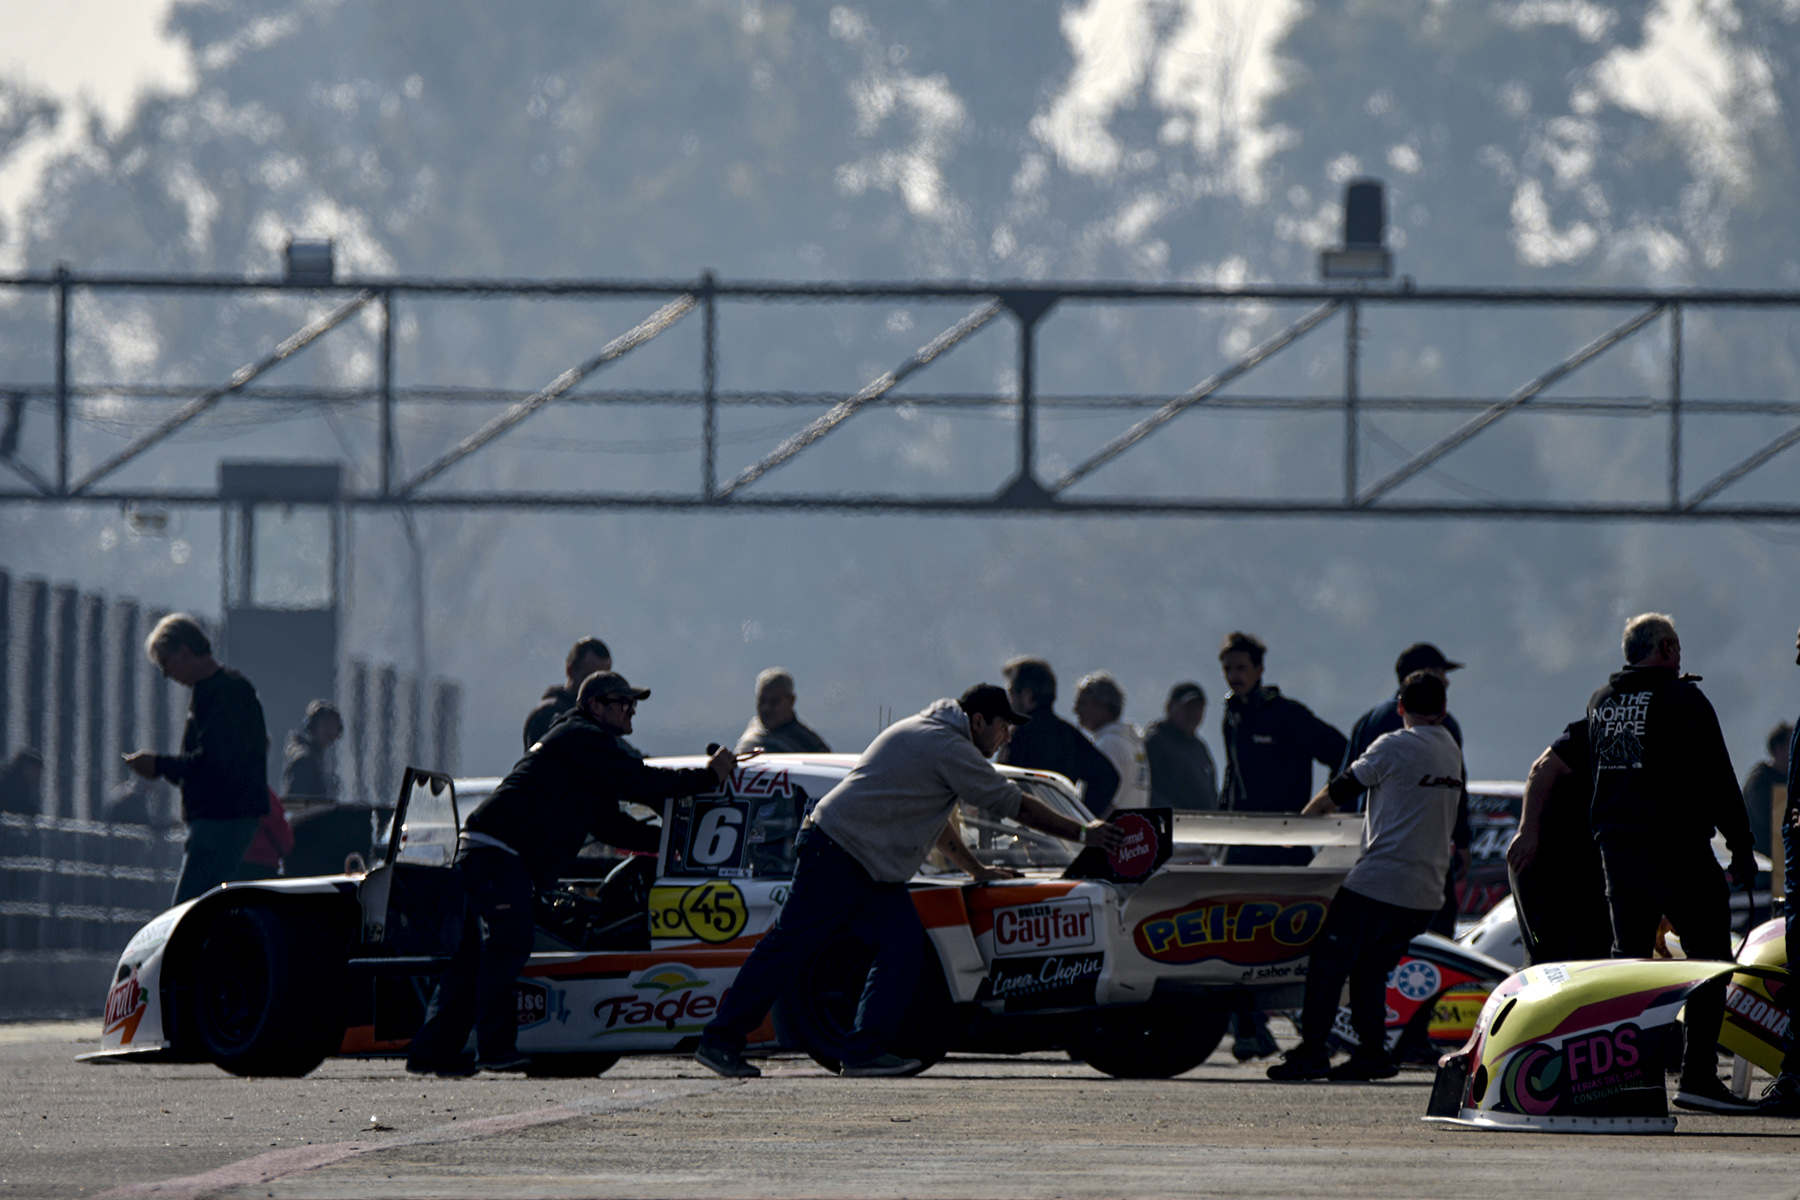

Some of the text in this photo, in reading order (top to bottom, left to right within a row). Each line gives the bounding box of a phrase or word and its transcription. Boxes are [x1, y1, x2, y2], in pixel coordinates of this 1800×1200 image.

[1619, 691, 1654, 706] THE
[1592, 705, 1648, 724] NORTH
[1604, 721, 1646, 738] FACE
[692, 807, 743, 864] 6
[1118, 843, 1150, 864] Mecha
[690, 885, 737, 933] 45
[1018, 906, 1051, 919] DULCES
[996, 908, 1090, 947] Cayfar
[1256, 965, 1291, 978] sabor
[1567, 1028, 1640, 1082] FDS
[1572, 1067, 1643, 1095] FERIAS DEL SUR
